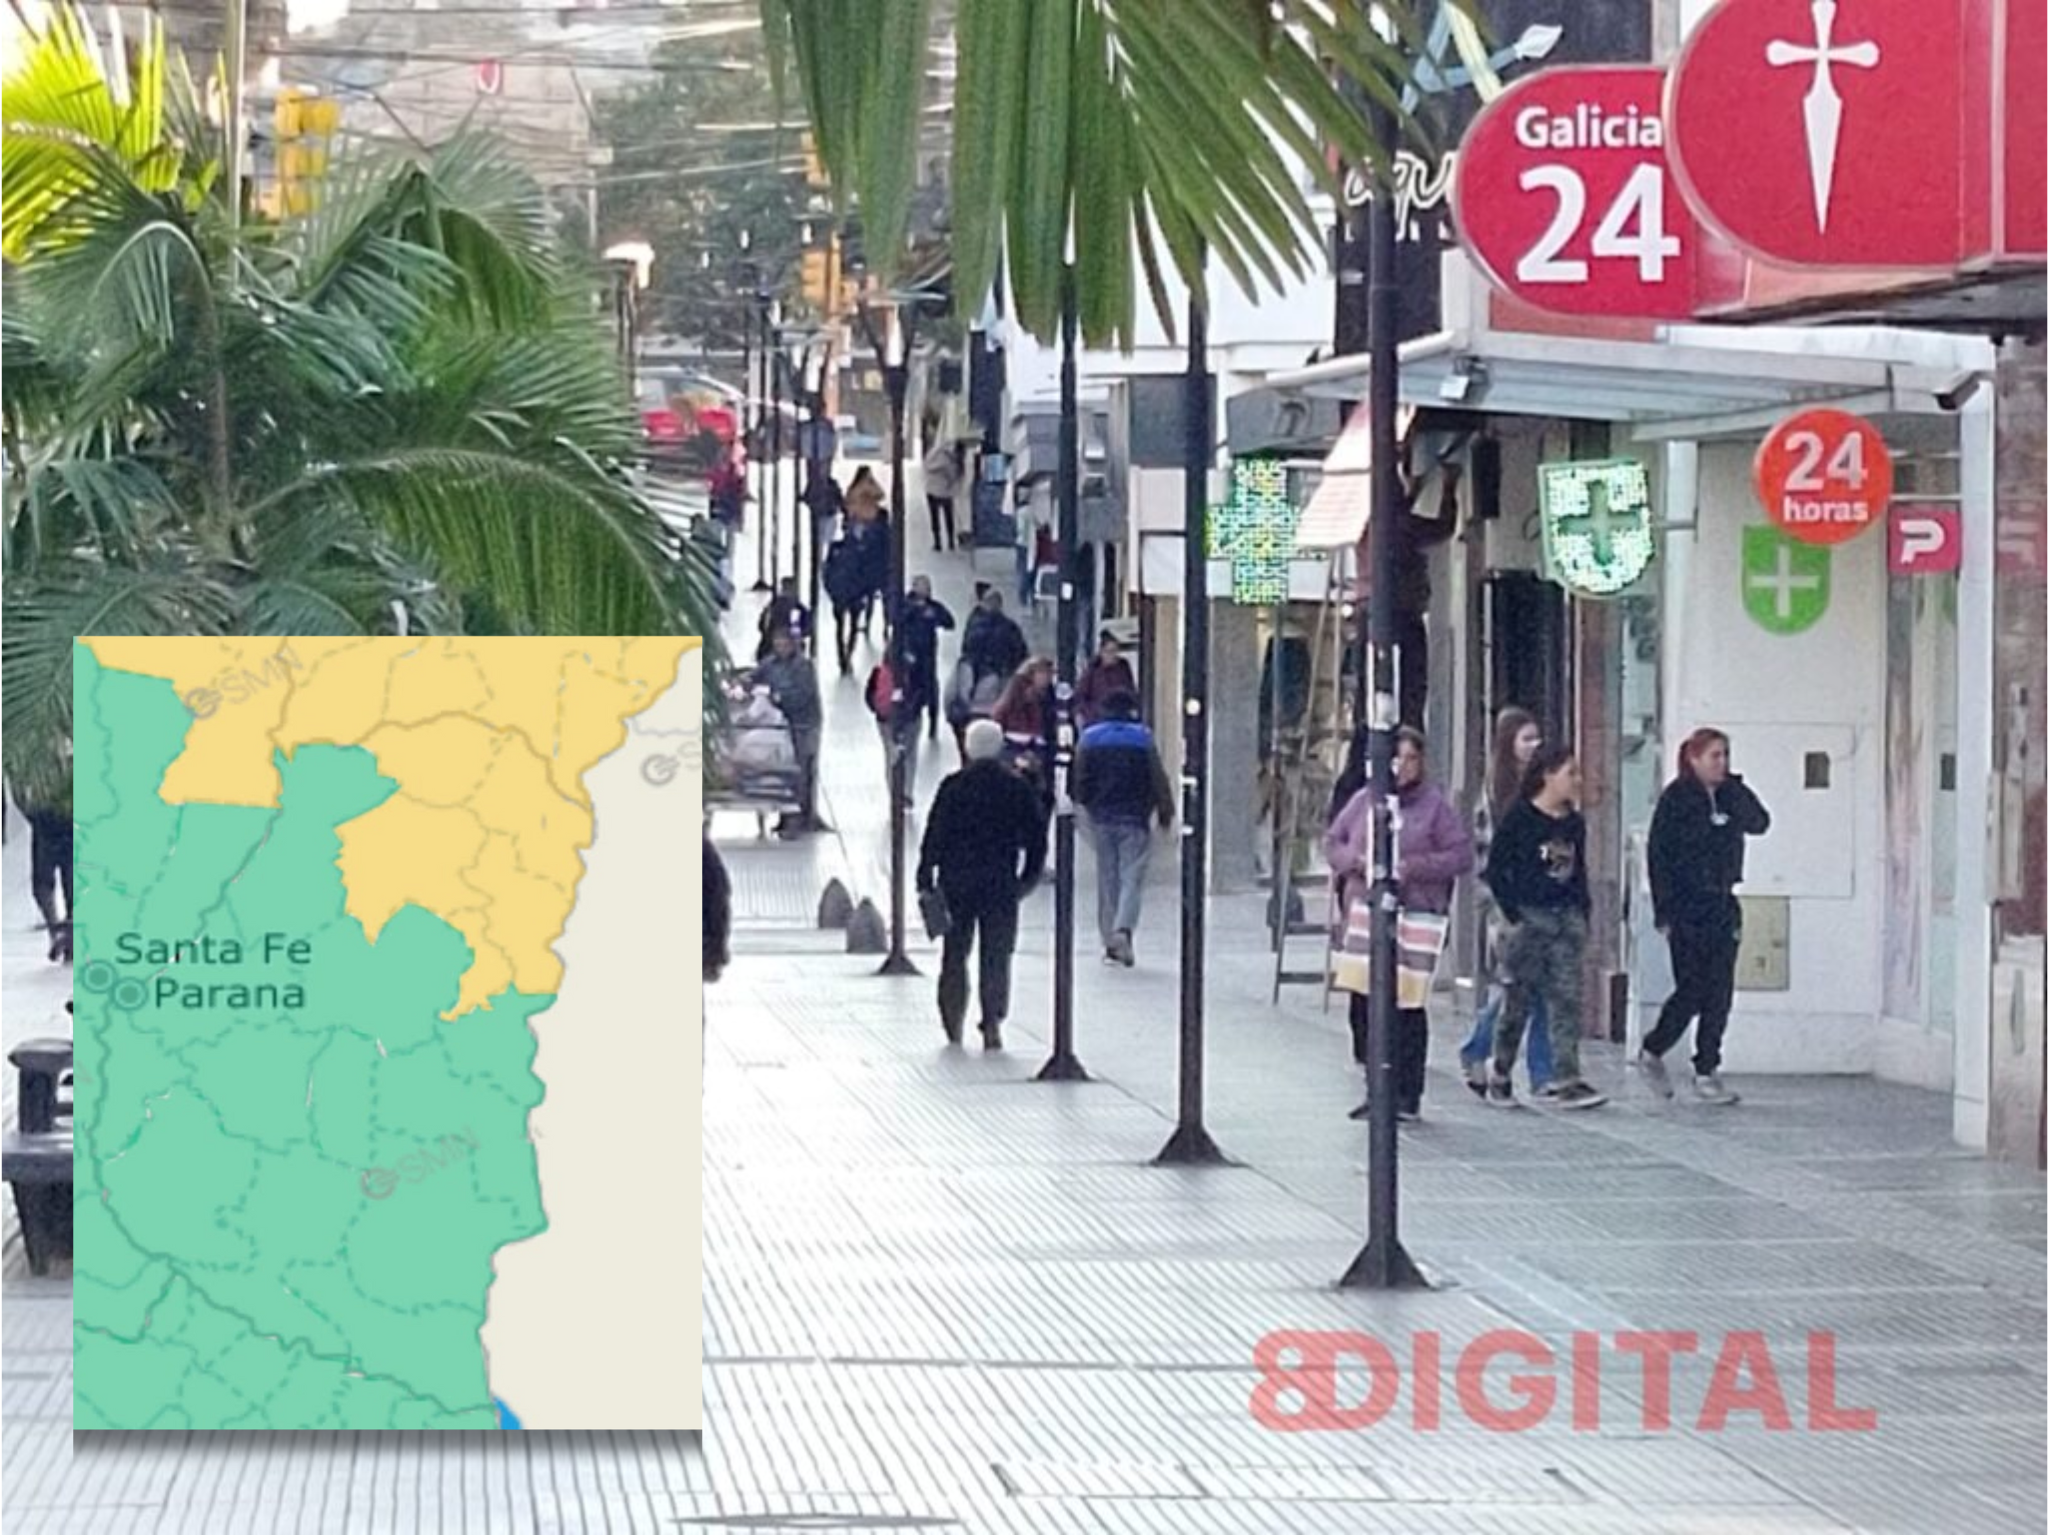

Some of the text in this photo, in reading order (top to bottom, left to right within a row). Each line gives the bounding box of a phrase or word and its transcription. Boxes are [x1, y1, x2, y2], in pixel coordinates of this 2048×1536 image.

[1515, 103, 1663, 148] Galicia
[1516, 162, 1681, 282] 24
[1784, 430, 1868, 491] 24
[1783, 496, 1868, 523] horas
